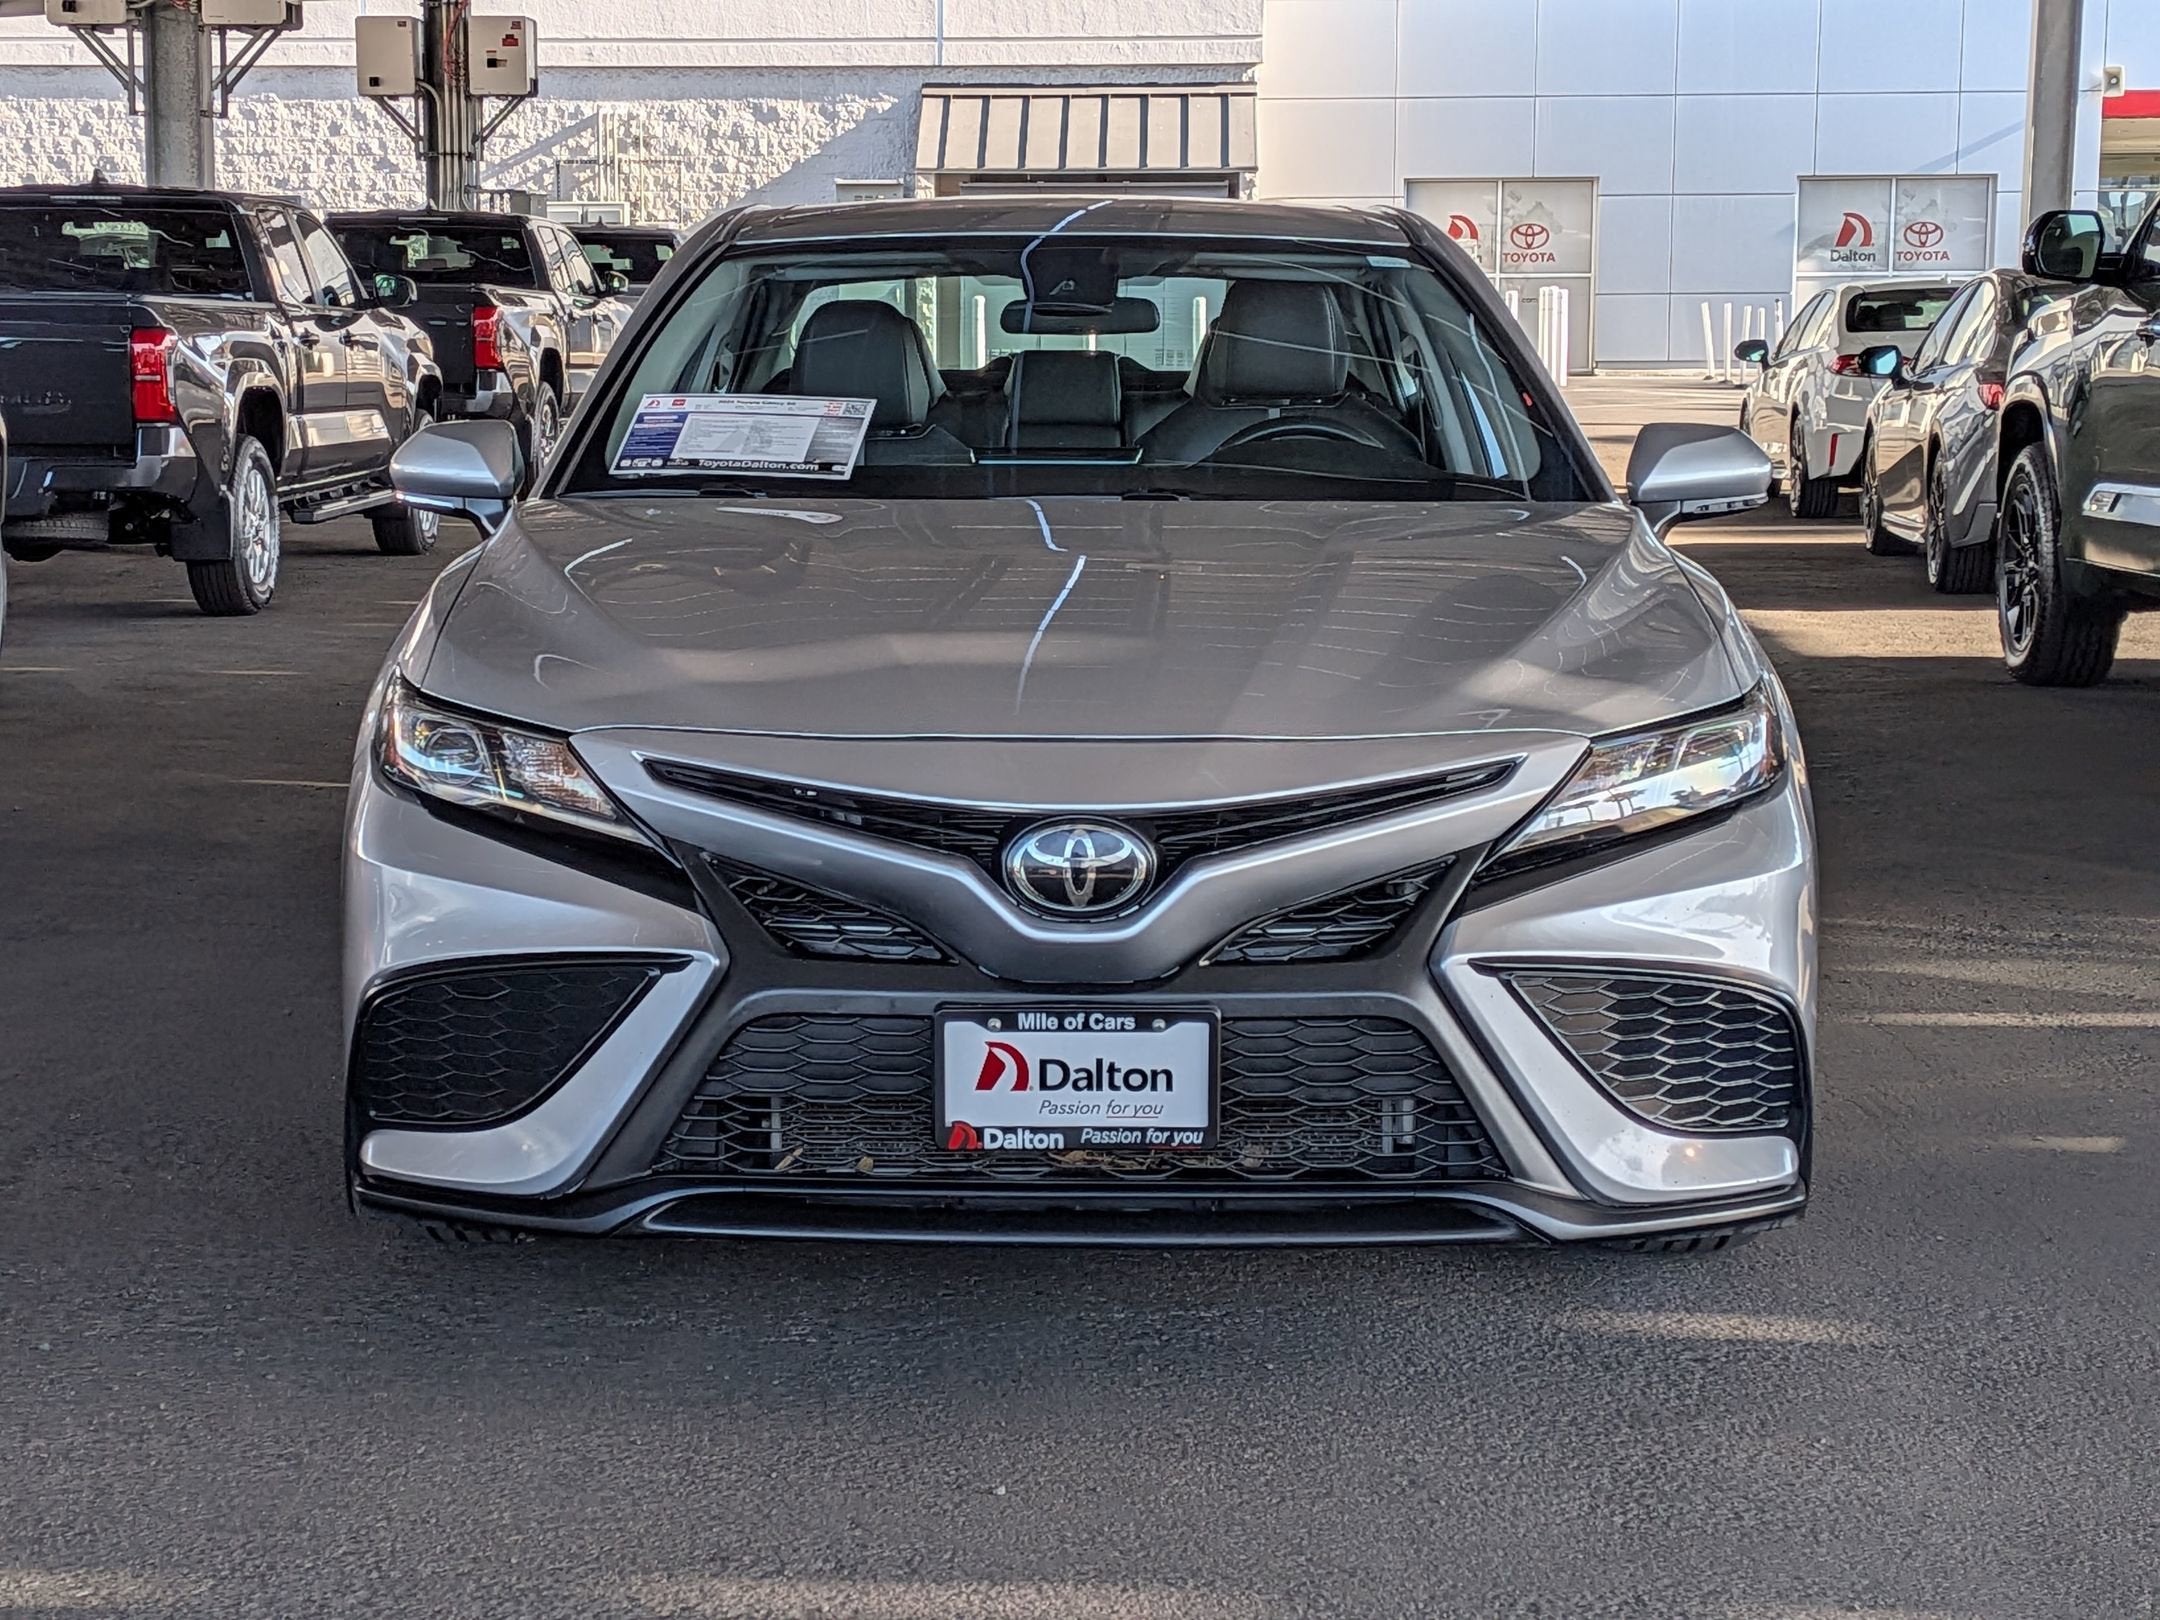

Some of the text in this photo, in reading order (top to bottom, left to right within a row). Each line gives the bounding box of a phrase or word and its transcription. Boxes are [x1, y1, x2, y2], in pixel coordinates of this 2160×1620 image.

[1503, 252, 1556, 263] TOYOTA
[1830, 249, 1876, 262] Dalton
[1896, 251, 1951, 261] TOYOTA
[698, 459, 819, 471] ToyotaDalton.com
[1018, 1013, 1136, 1031] Mile of Cars
[1039, 1058, 1174, 1092] Dalton
[1039, 1100, 1164, 1117] Passion for you
[984, 1128, 1204, 1150] Dalton Passion for you
